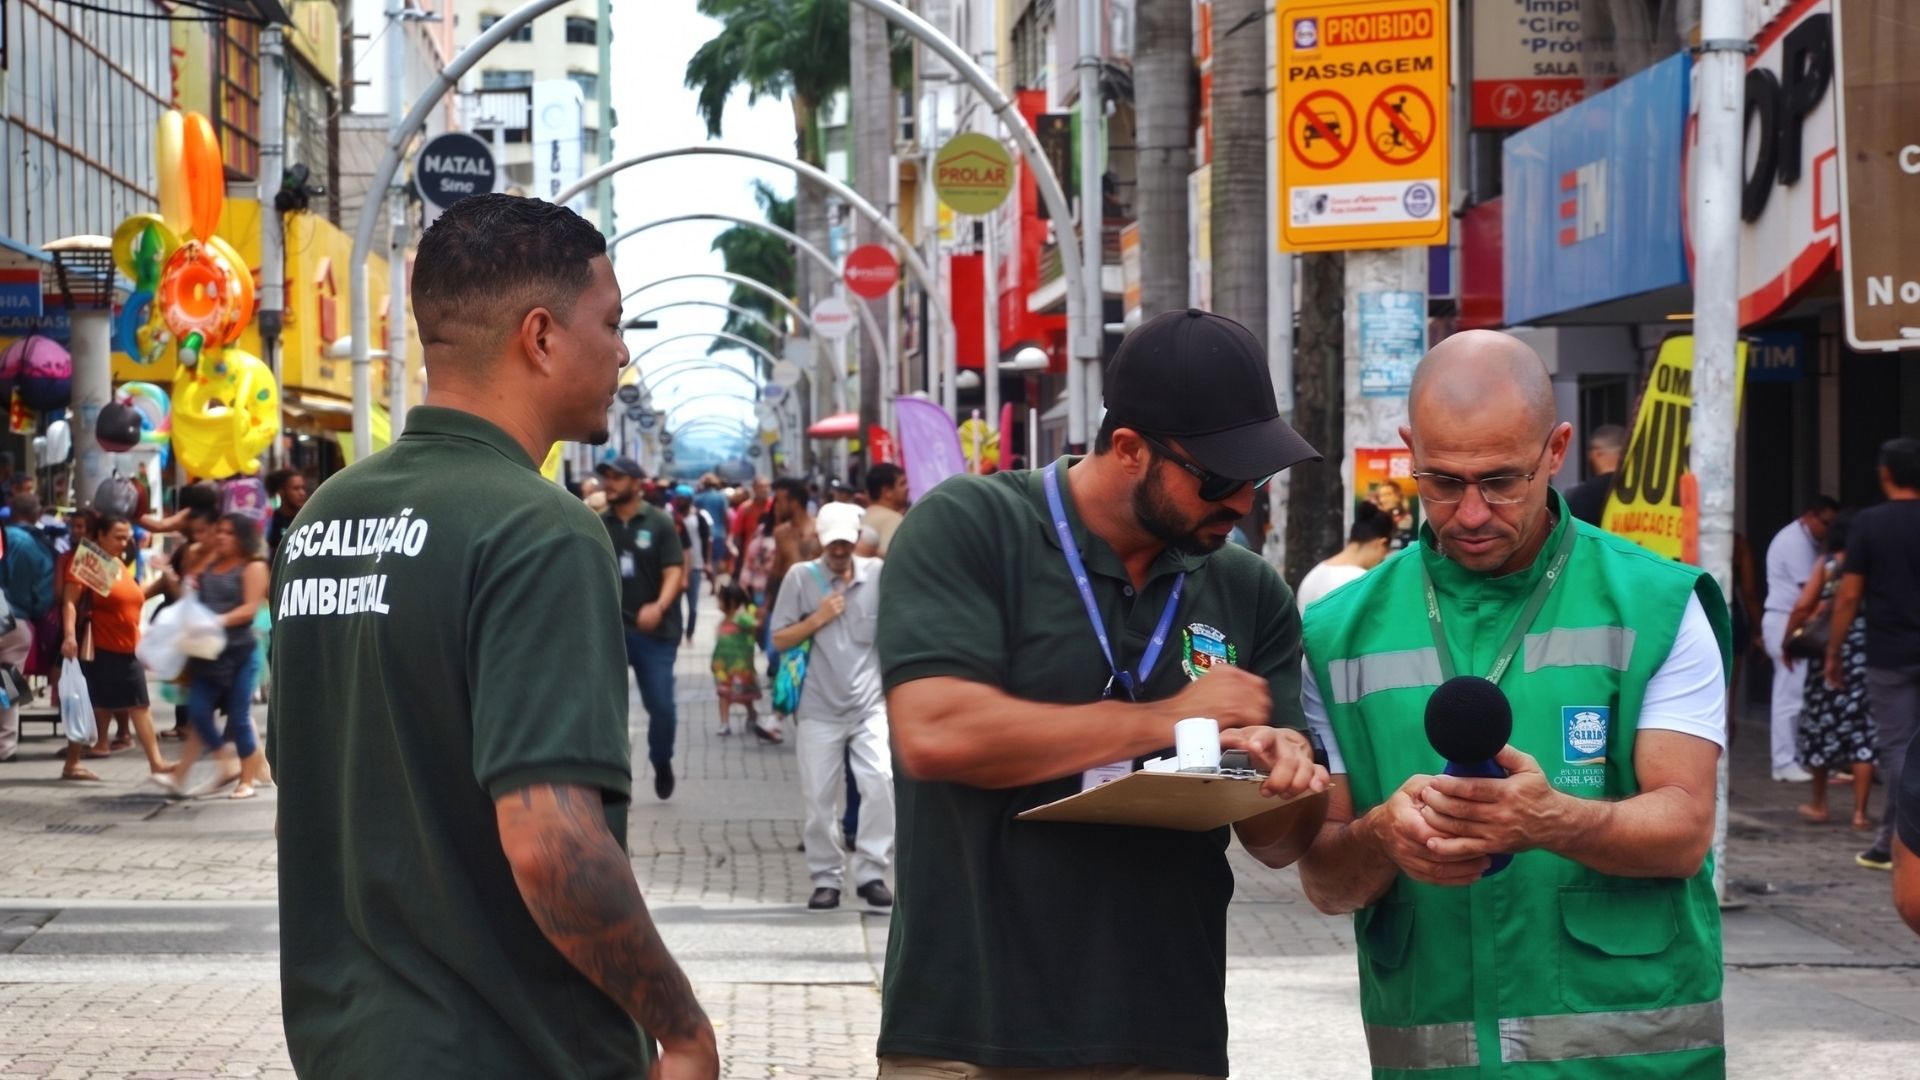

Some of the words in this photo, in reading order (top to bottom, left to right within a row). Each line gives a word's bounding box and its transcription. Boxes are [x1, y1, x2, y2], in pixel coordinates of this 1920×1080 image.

[1327, 11, 1431, 44] PROIBIDO
[1289, 56, 1434, 82] PASSAGEM
[1534, 62, 1578, 75] SALA
[424, 155, 491, 177] NATAL
[938, 167, 1006, 183] PROLAR
[1749, 346, 1796, 368] TIM
